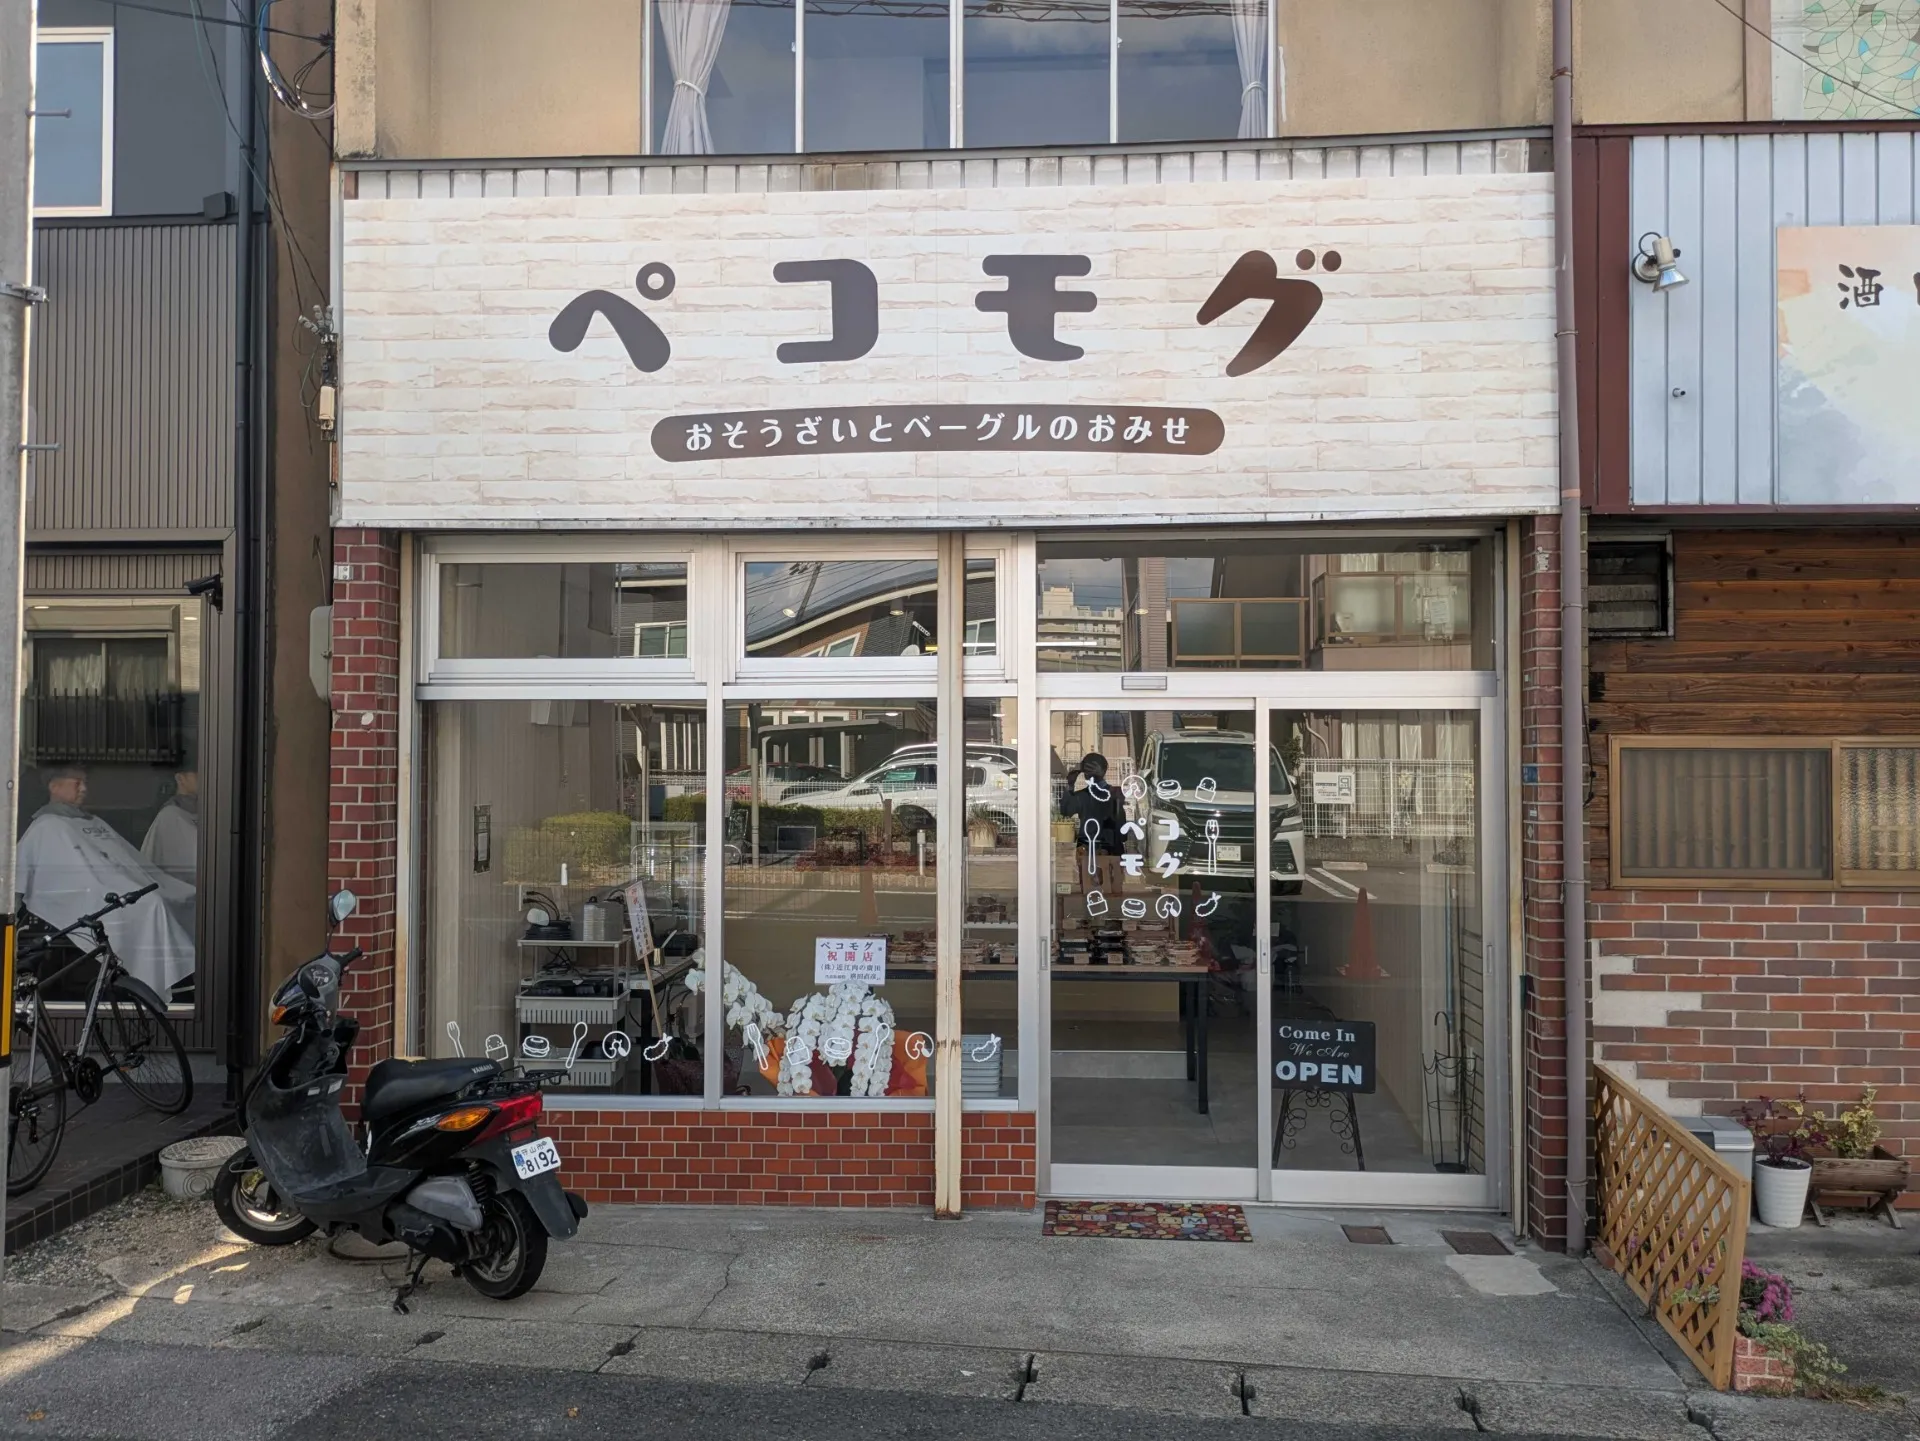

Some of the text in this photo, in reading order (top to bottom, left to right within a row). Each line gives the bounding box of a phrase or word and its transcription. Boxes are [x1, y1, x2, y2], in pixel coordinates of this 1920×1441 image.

[548, 249, 1342, 377] ペコモグ
[685, 413, 1190, 451] おそうざいとベーグルのおみせ
[1120, 818, 1180, 841] ペコ
[1120, 851, 1184, 879] モグ
[1279, 1025, 1356, 1042] Come In
[1289, 1043, 1350, 1058] We Are
[1275, 1060, 1363, 1085] OPEN
[526, 1148, 558, 1172] 8192
